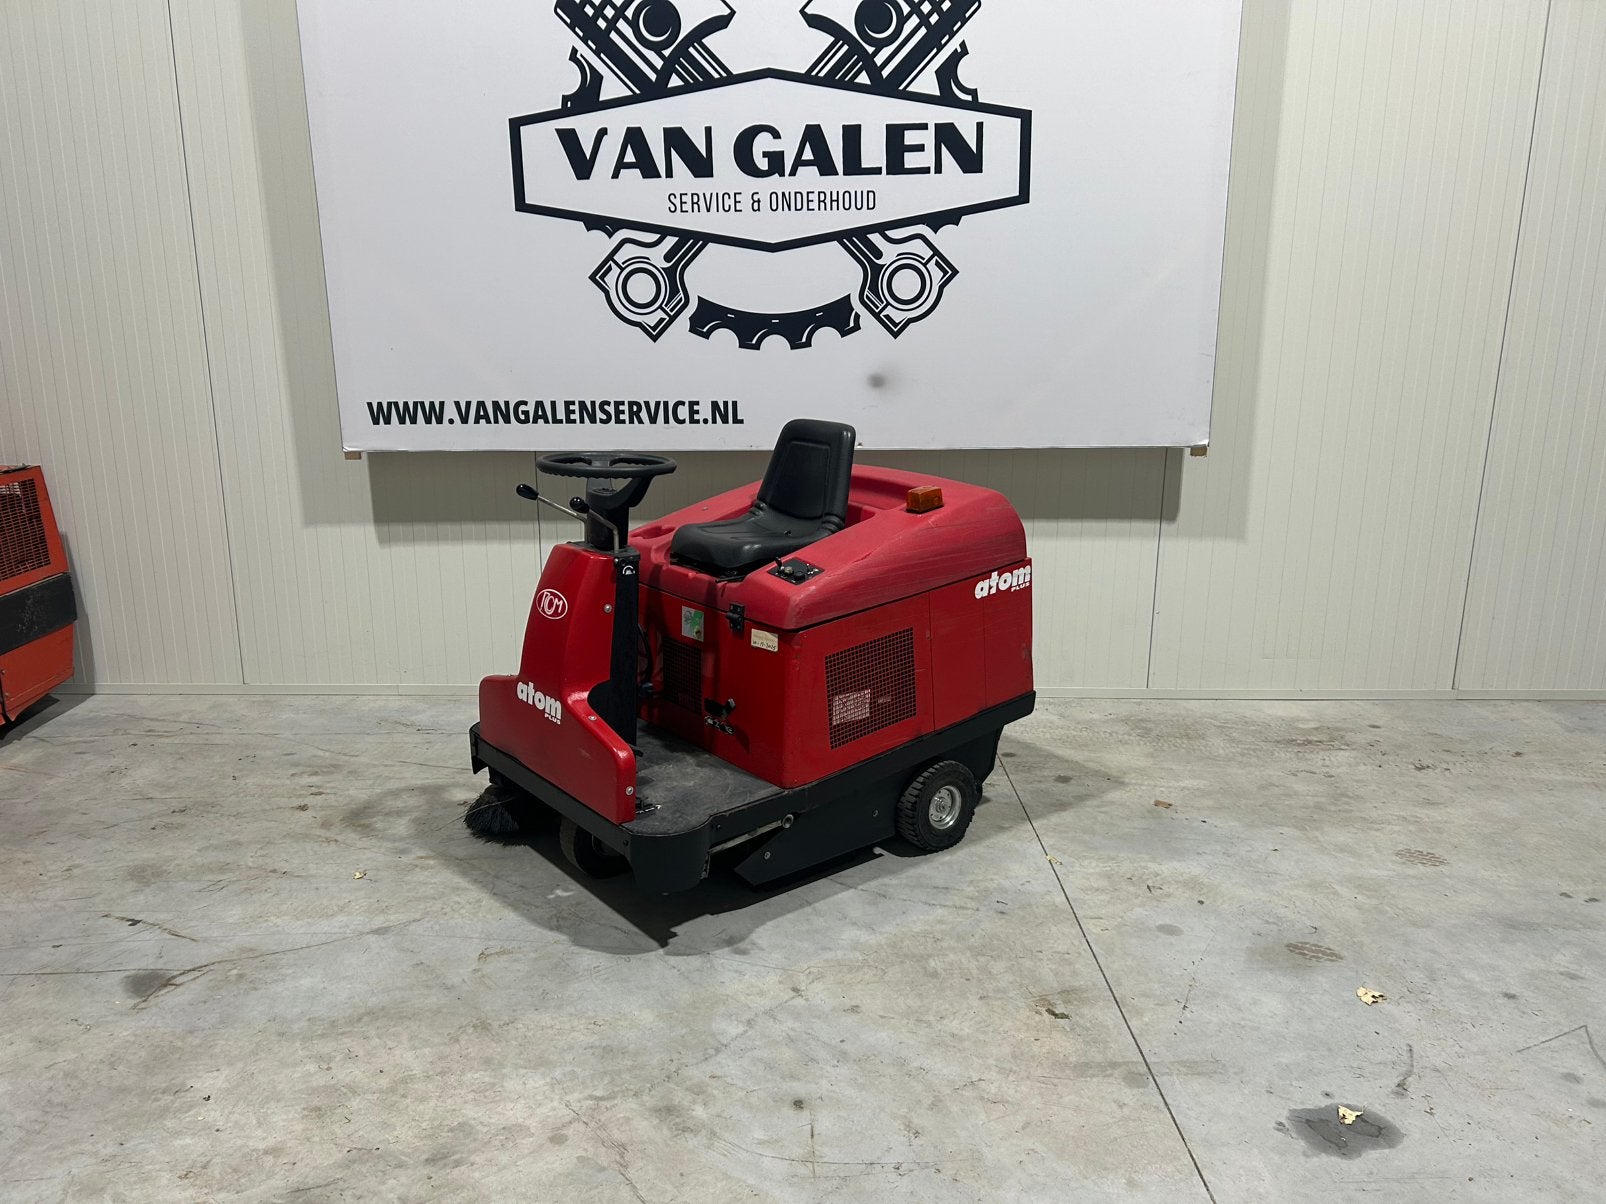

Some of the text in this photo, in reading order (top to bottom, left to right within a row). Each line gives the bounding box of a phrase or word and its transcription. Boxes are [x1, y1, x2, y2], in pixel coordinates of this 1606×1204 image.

[554, 121, 984, 181] VAN GALEN
[667, 189, 877, 214] SERVICE & ONDERHOUD
[366, 399, 745, 426] WWW.VANGALENSERVICE.NL
[974, 565, 1031, 599] atom
[516, 681, 562, 720] atom
